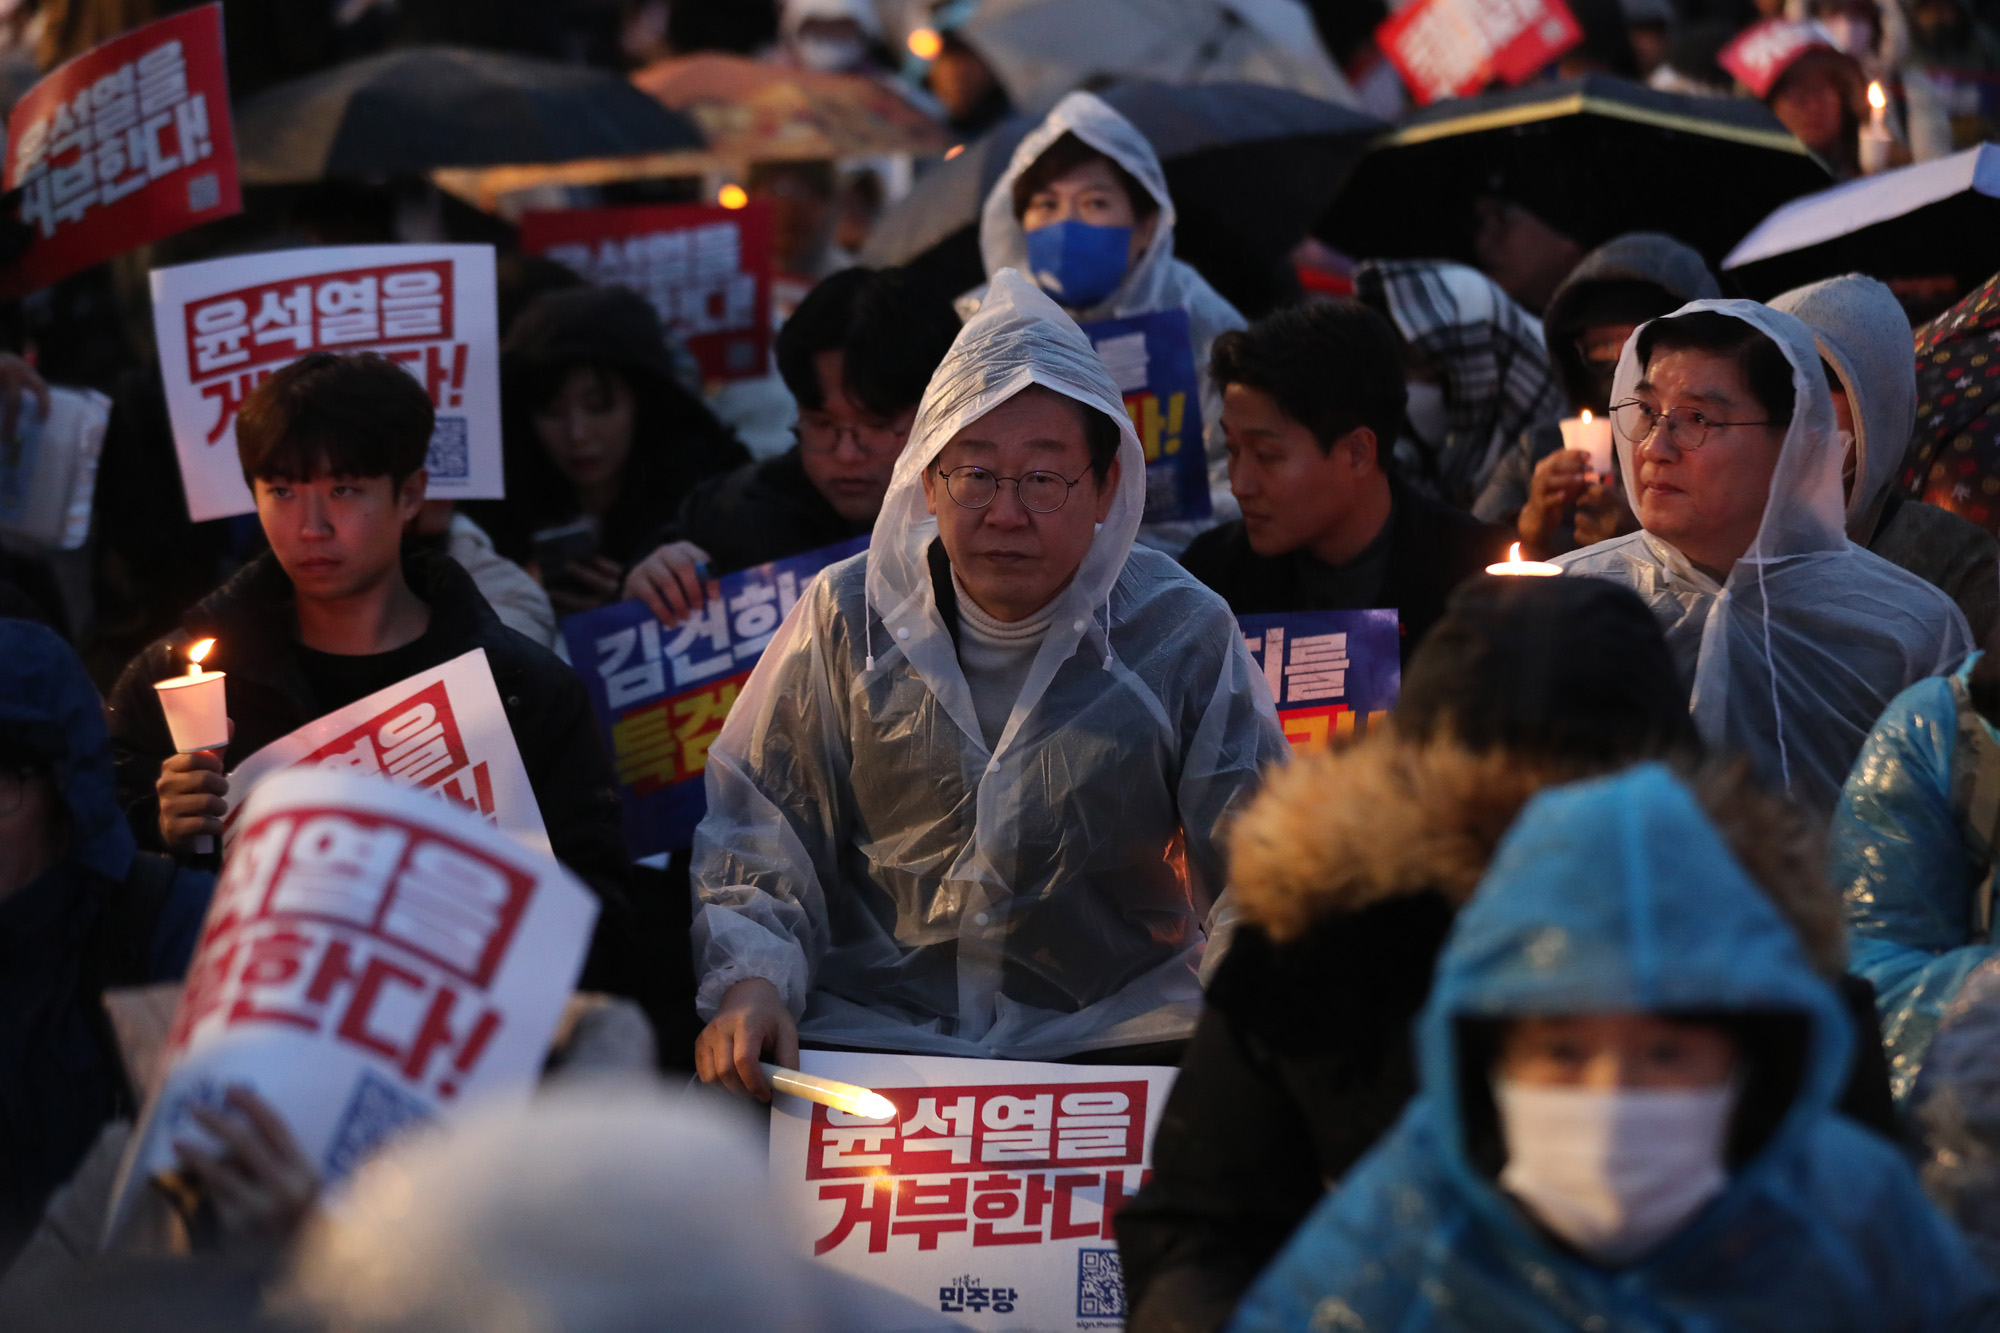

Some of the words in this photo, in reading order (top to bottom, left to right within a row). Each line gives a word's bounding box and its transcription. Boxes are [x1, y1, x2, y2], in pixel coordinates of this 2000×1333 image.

[193, 269, 443, 374] 윤석열을
[596, 571, 816, 711] 김건희
[821, 1091, 1131, 1170] 윤석열을
[939, 1287, 1018, 1313] 민주당
